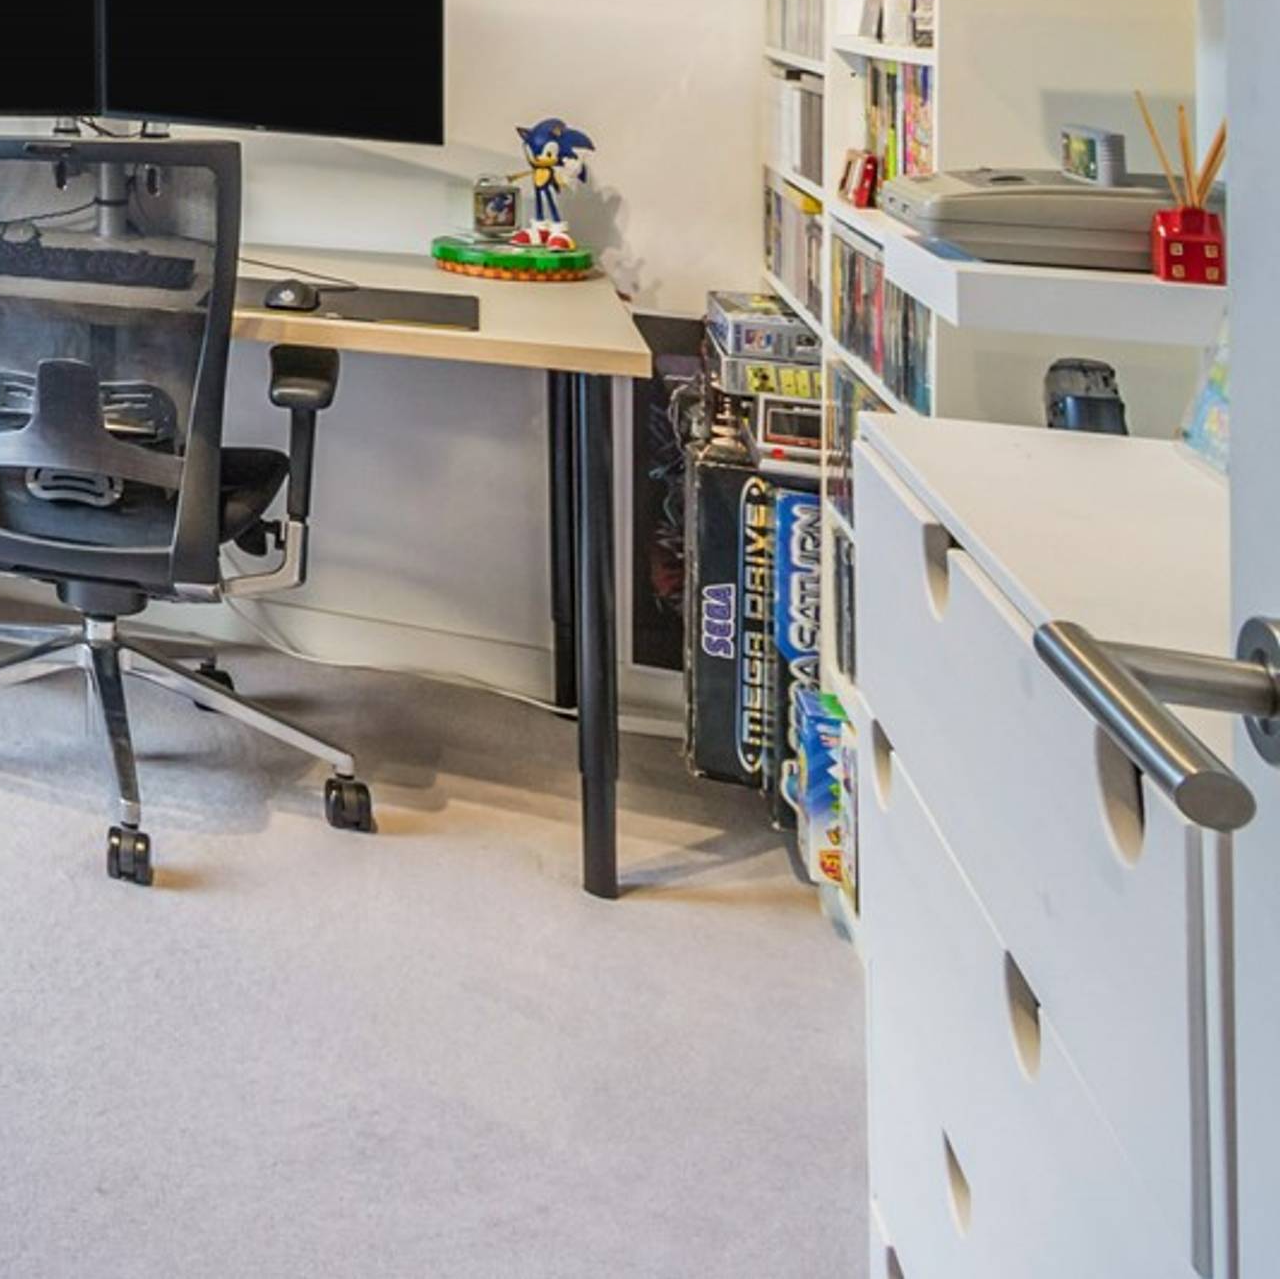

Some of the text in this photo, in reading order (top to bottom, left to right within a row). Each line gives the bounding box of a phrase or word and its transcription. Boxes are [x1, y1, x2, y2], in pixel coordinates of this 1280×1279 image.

[701, 583, 737, 660] SEGA
[742, 502, 768, 746] MEGA DRIVE
